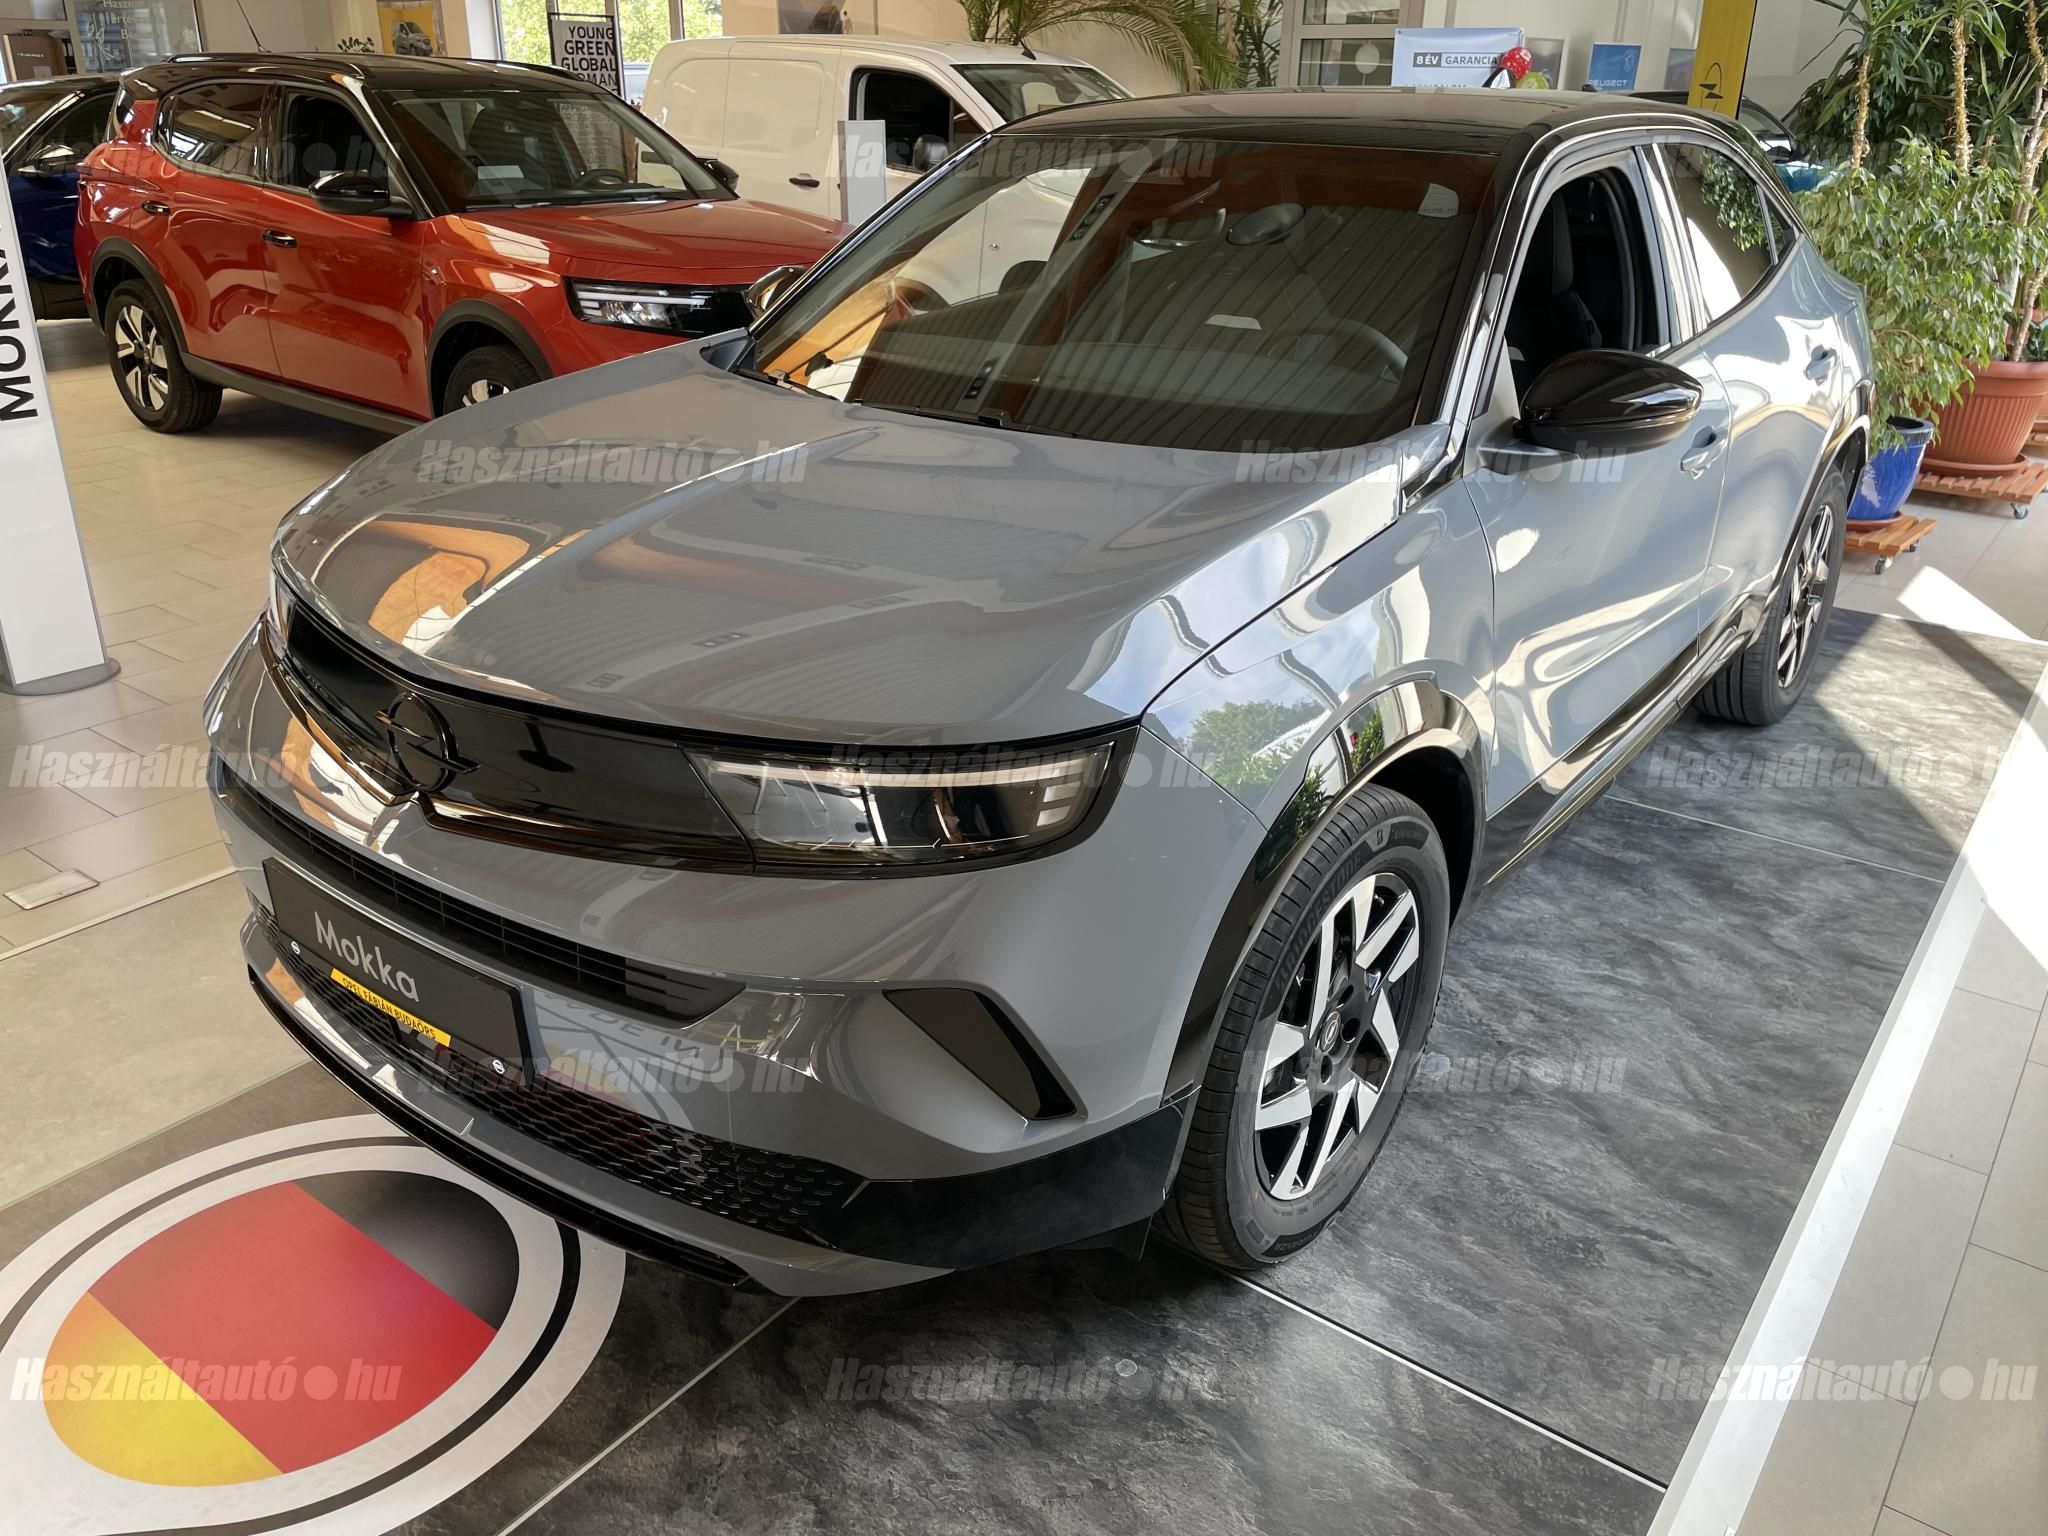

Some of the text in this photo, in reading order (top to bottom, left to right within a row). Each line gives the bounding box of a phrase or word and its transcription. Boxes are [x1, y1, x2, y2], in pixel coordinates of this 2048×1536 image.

[568, 26, 614, 40] YOUNG
[564, 40, 616, 56] GREEN
[561, 57, 617, 72] GLOBAL
[1416, 56, 1424, 65] 8
[1445, 55, 1498, 65] GARANCIA
[314, 911, 420, 1003] Mokka
[342, 977, 361, 997] OPEL
